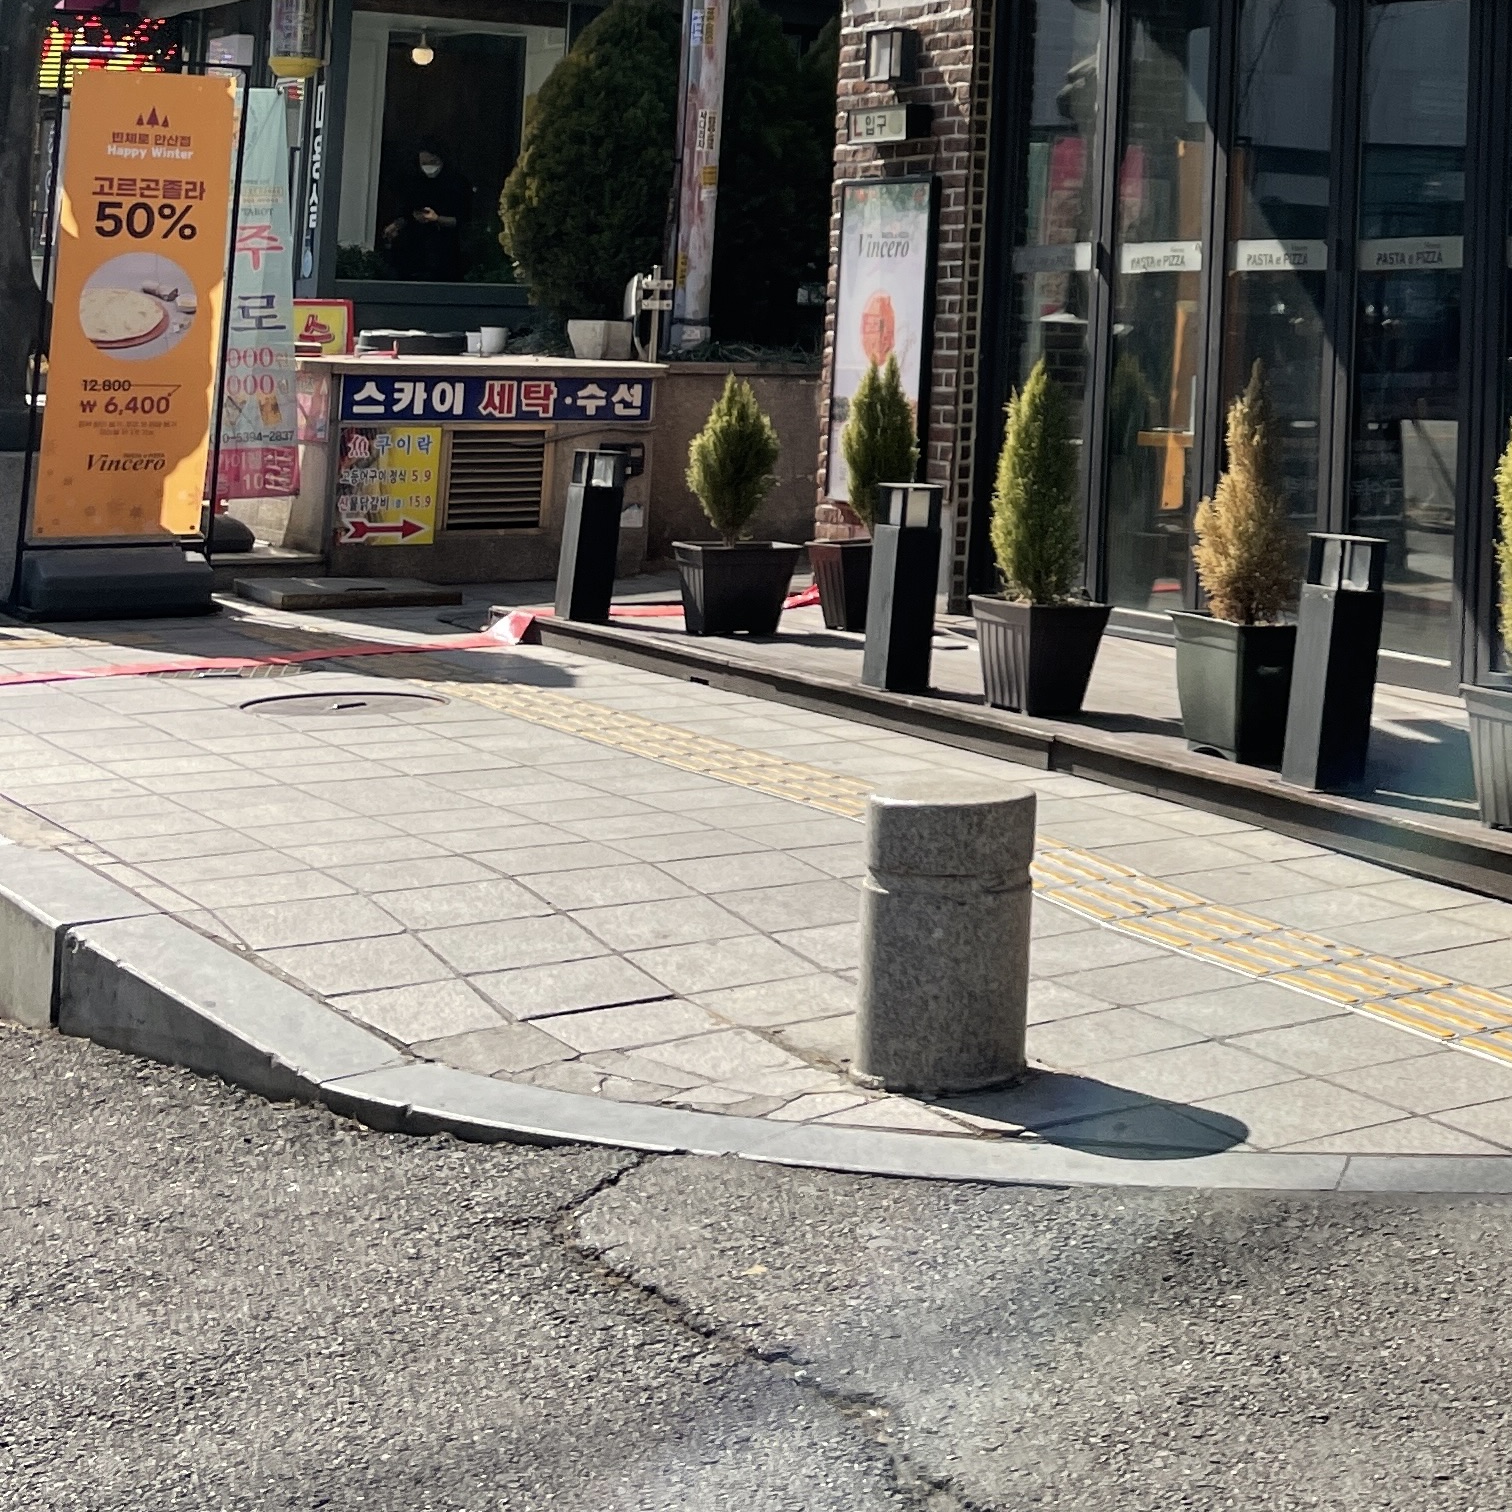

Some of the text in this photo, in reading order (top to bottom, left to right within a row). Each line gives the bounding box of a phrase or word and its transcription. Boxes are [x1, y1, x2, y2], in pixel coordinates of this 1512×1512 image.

[865, 114, 887, 137] 입구
[107, 144, 194, 160] Happy Winter
[95, 200, 198, 241] 50%
[858, 232, 910, 259] Vincero
[1246, 254, 1275, 267] PASTA
[1284, 253, 1309, 266] PIZZA
[1375, 252, 1406, 267] PASTA
[1416, 251, 1444, 266] PIZZA
[104, 395, 170, 417] 6,400
[351, 380, 465, 416] 스카이
[87, 453, 166, 472] Vincero
